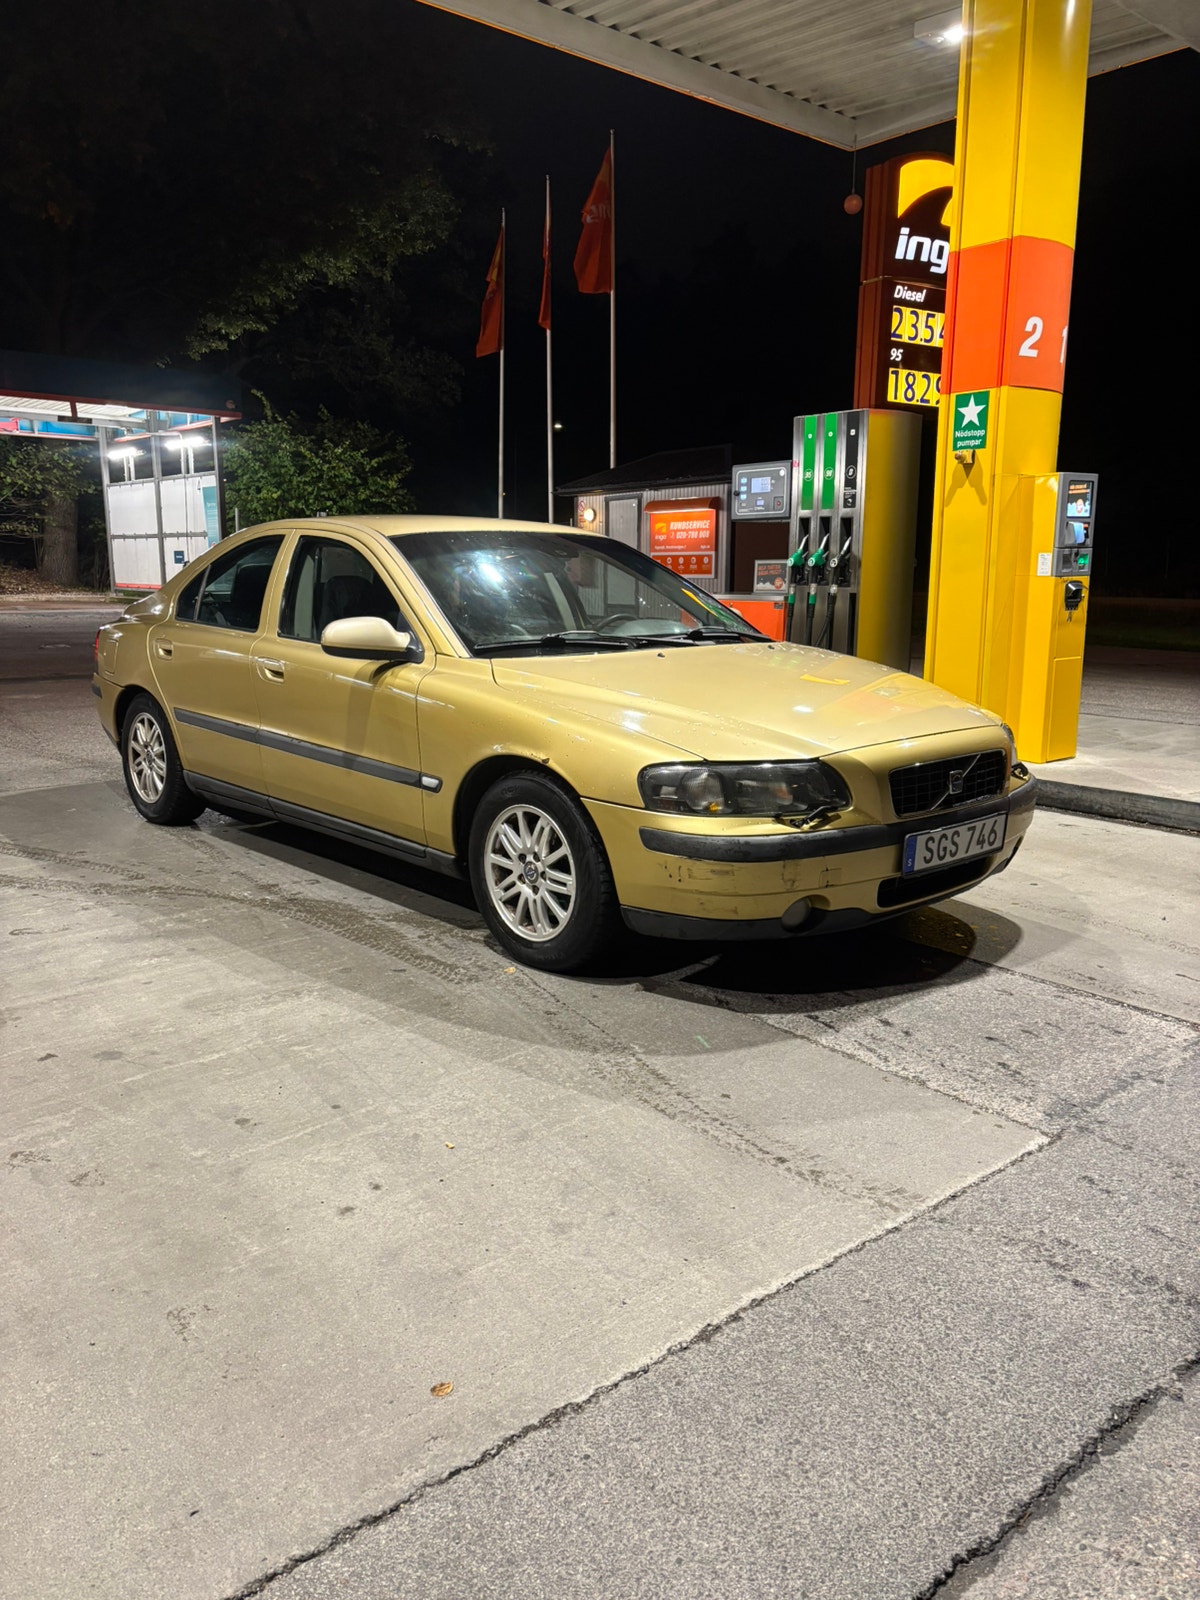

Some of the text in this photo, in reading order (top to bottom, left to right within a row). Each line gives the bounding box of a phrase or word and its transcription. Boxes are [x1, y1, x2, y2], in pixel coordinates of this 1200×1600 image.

[894, 285, 927, 302] Diesel
[1018, 317, 1043, 358] 2
[890, 347, 904, 361] 95
[955, 428, 985, 439] Nödstopp
[957, 438, 982, 448] pumpar
[670, 520, 711, 530] KUNDSERVICE
[924, 820, 998, 864] SGS 746
[907, 859, 912, 867] S
